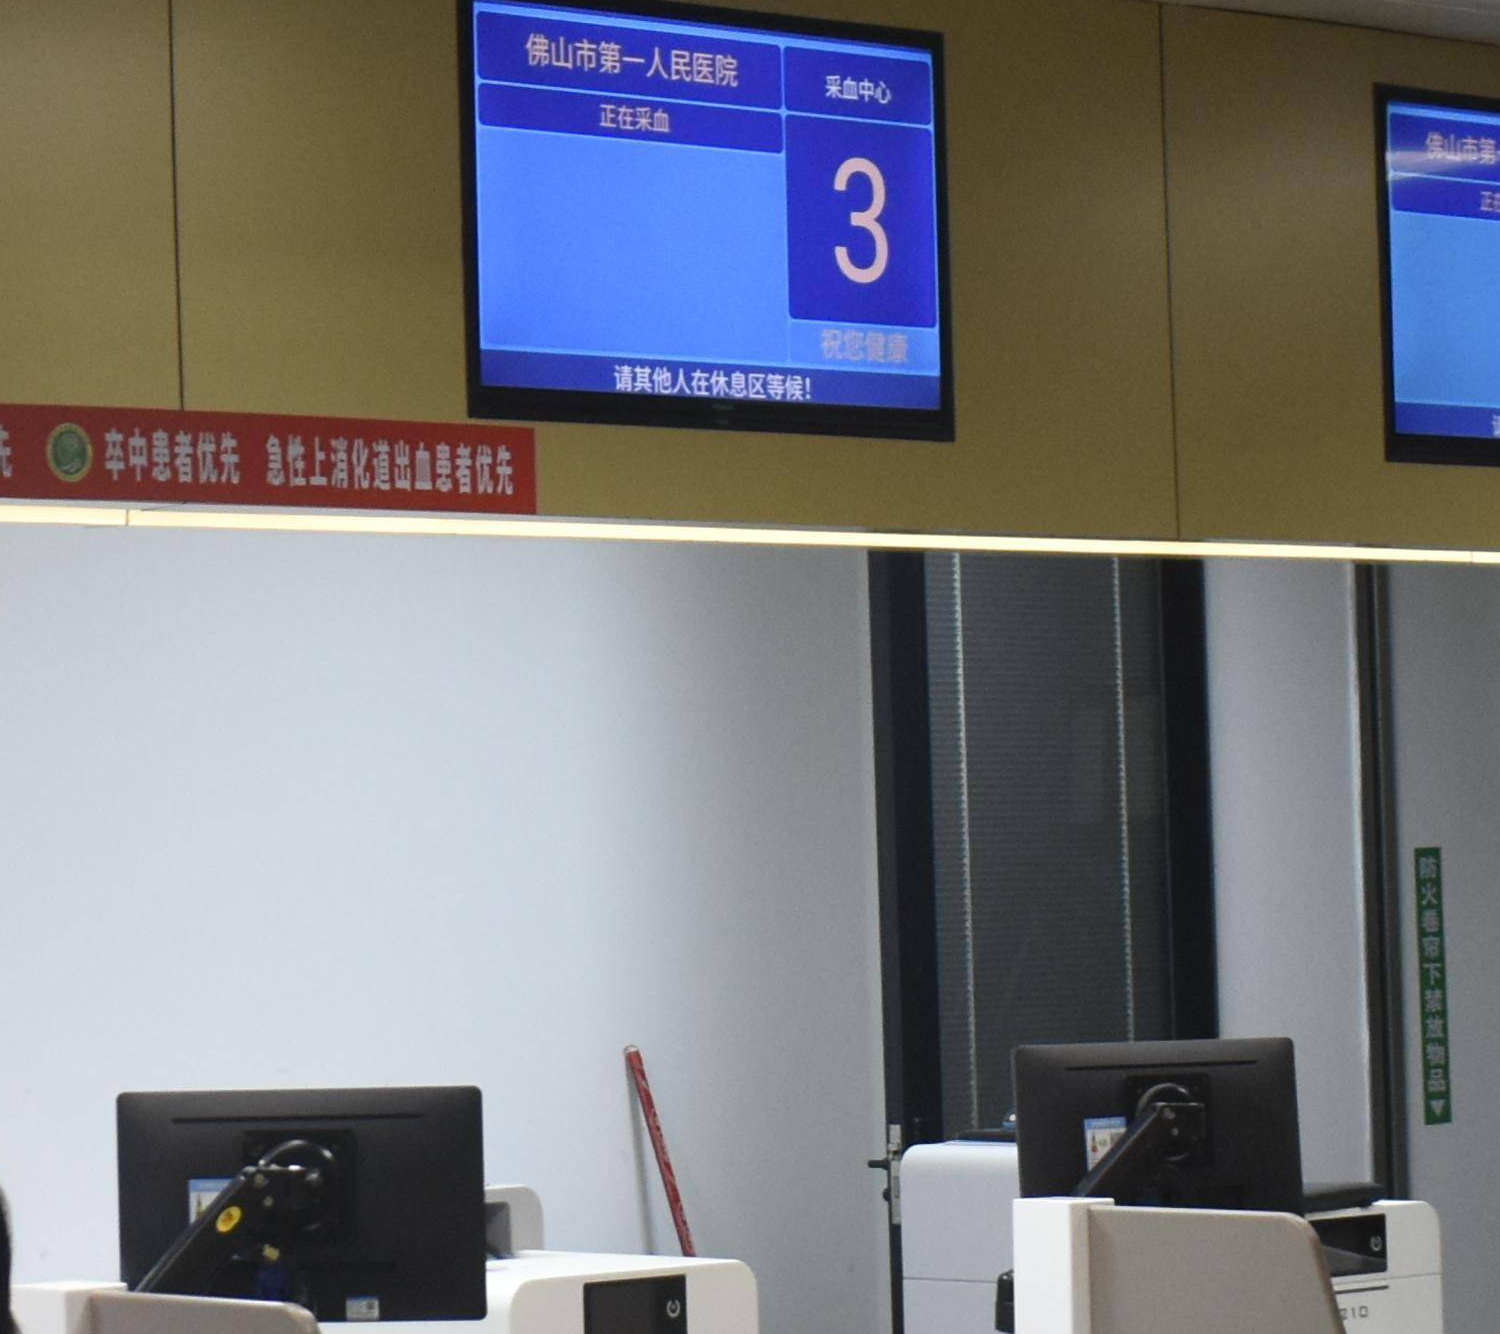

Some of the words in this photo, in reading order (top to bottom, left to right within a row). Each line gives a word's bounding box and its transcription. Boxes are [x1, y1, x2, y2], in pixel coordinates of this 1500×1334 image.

[525, 33, 739, 87] 佛山市第一人民医院
[825, 75, 892, 104] 采血中心
[599, 104, 670, 133] 正在采血
[833, 157, 889, 284] 3
[1338, 1305, 1369, 1320] 210
